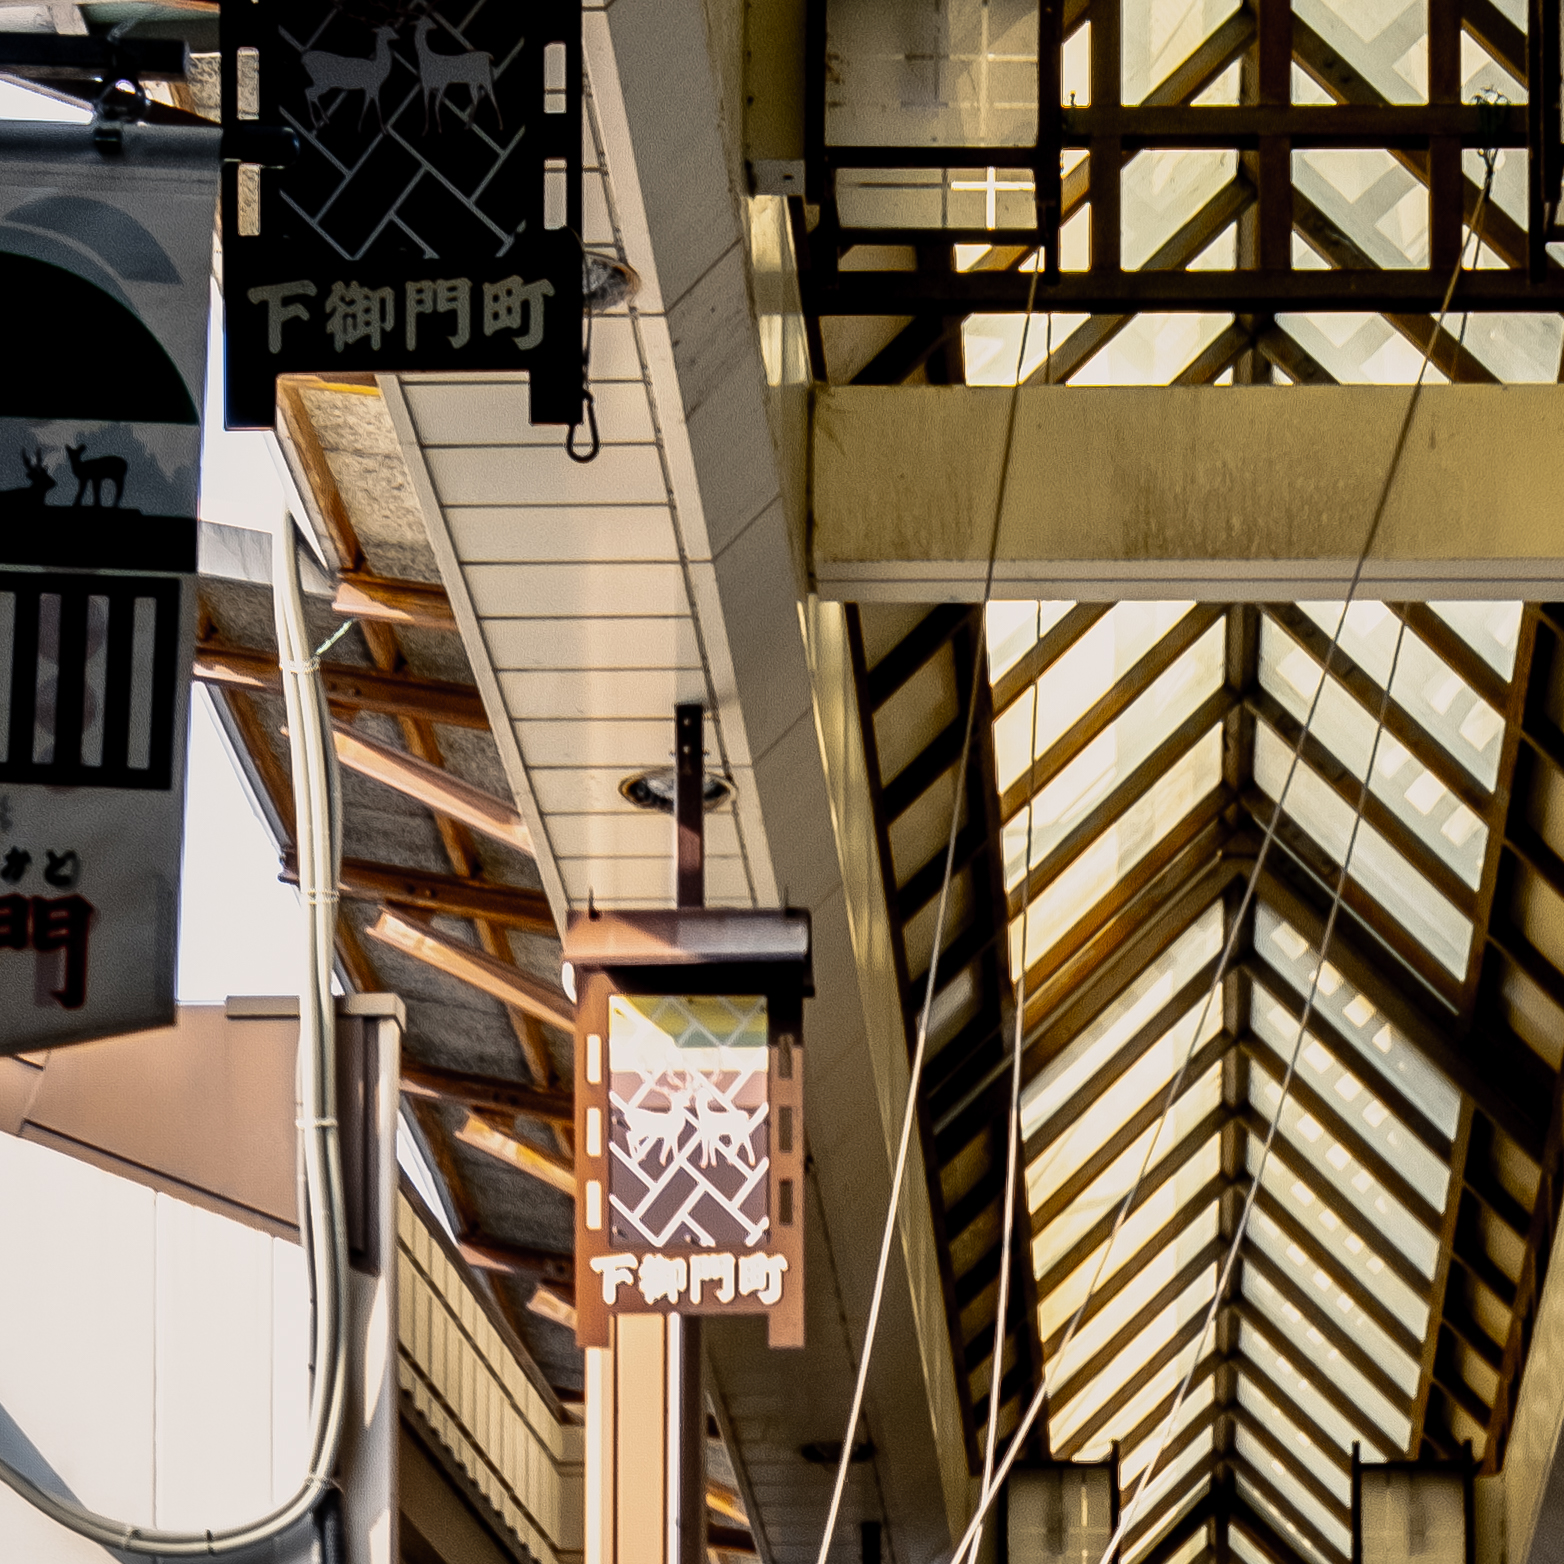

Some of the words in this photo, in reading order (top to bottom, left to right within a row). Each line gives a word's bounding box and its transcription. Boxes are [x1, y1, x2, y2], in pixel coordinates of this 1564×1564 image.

[247, 275, 555, 353] 下御門町
[590, 1252, 788, 1305] 下御門町
